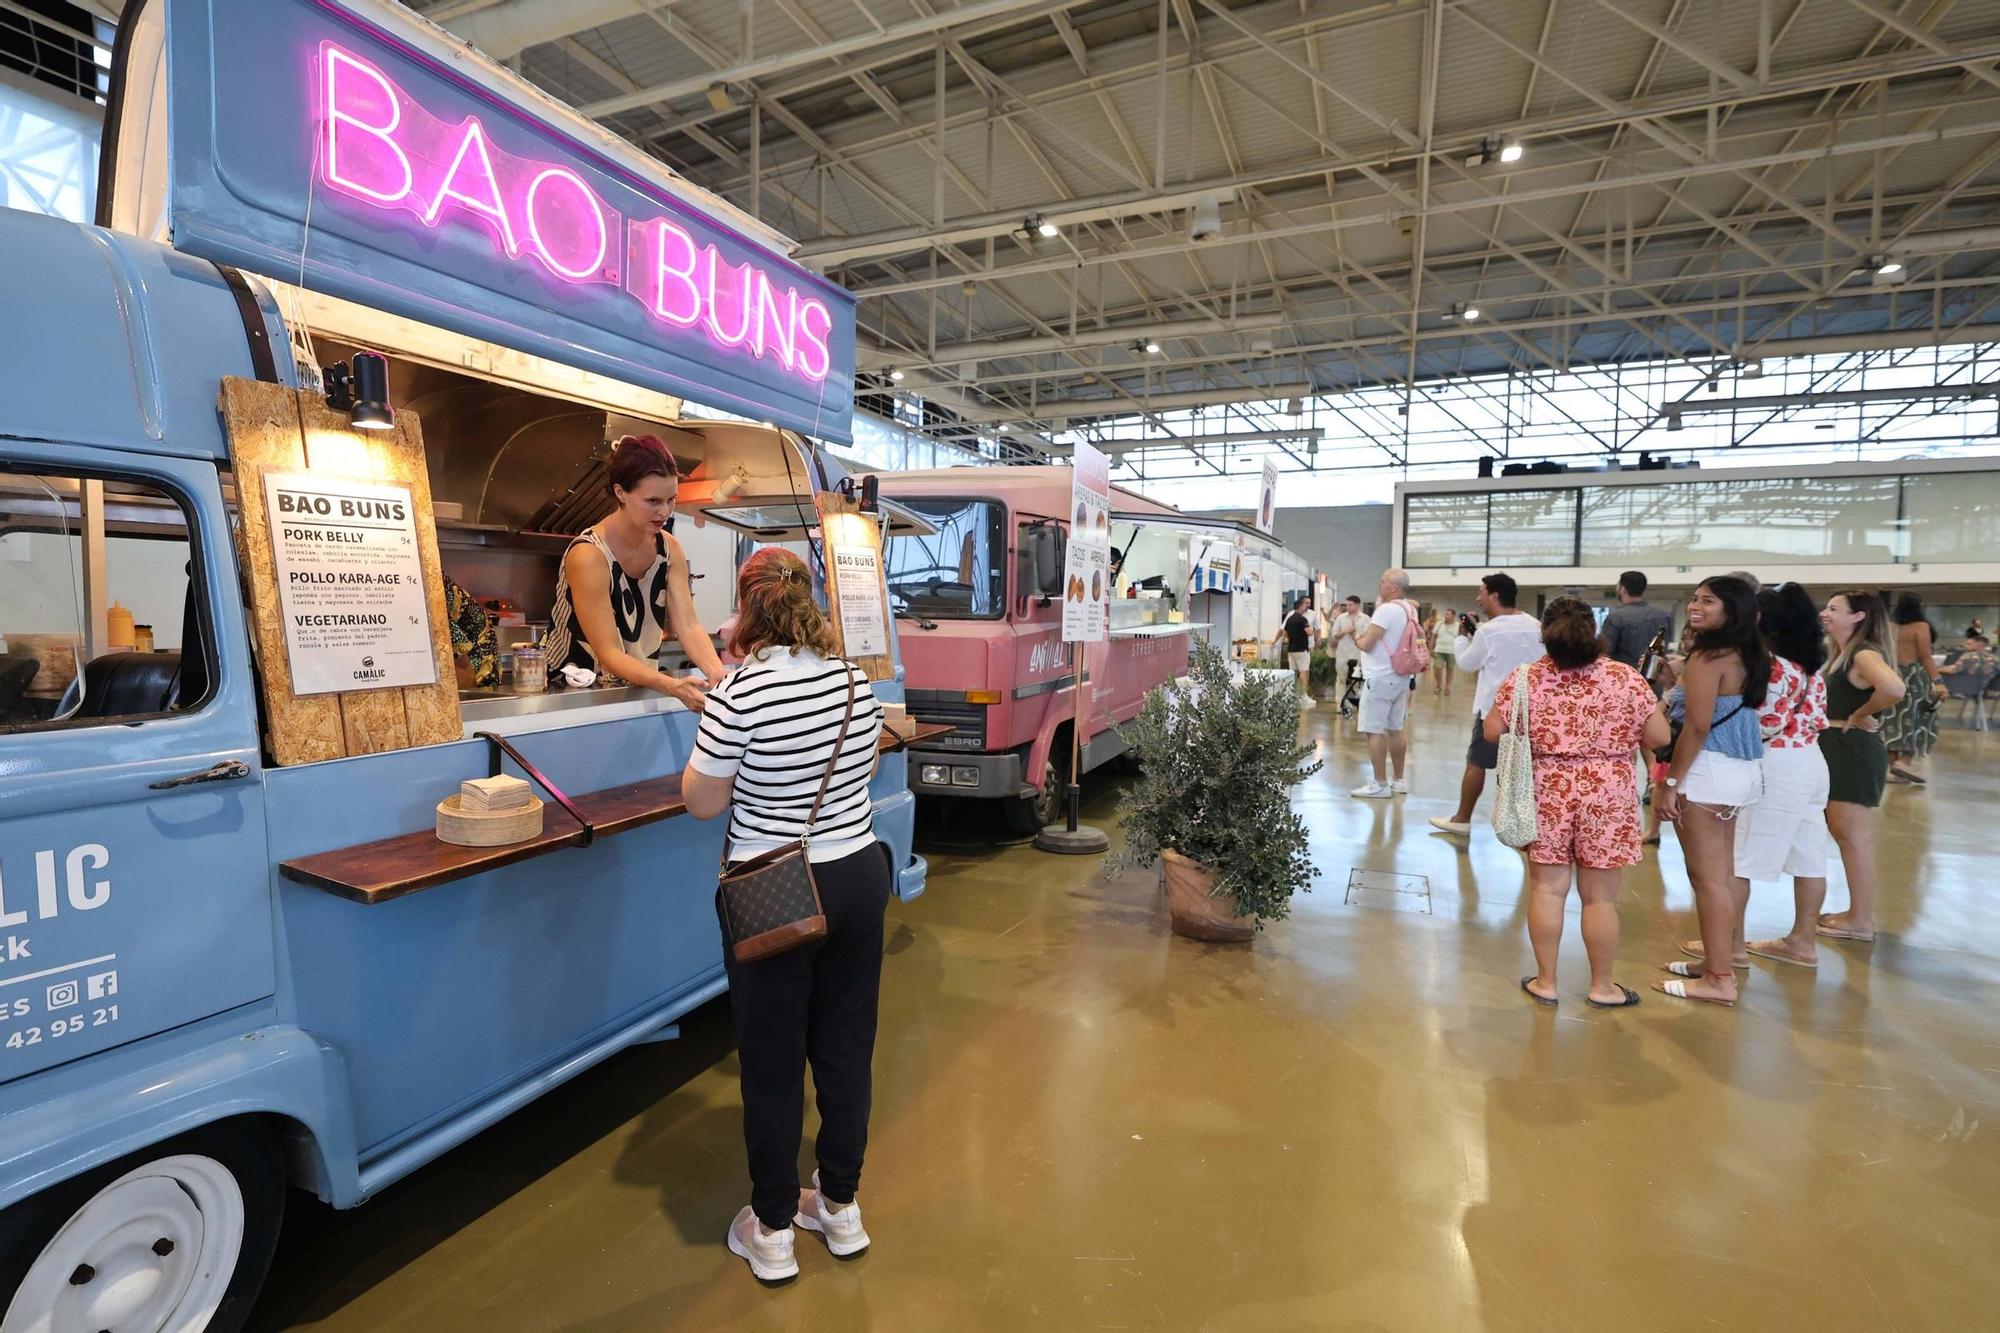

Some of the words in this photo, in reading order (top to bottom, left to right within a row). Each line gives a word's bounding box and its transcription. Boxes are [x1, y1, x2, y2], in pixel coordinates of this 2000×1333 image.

[327, 46, 607, 278] BAO
[656, 221, 832, 379] BUNS
[277, 493, 331, 515] BAO
[340, 499, 406, 521] BUNS
[284, 528, 324, 541] PORK
[326, 531, 364, 543] BELLY
[401, 536, 411, 545] 9€
[837, 556, 853, 566] BAO
[855, 556, 875, 567] BUNS
[290, 572, 336, 584] POLLO
[339, 573, 401, 585] KARA-AGE
[294, 614, 387, 627] VEGETARIANO
[1131, 641, 1155, 658] STREET
[353, 668, 386, 680] CAMÀLIC
[944, 736, 982, 746] EBRO
[0, 935, 32, 963] k
[6, 1026, 43, 1049] 42
[51, 1013, 85, 1038] 95
[92, 1004, 119, 1027] 21
